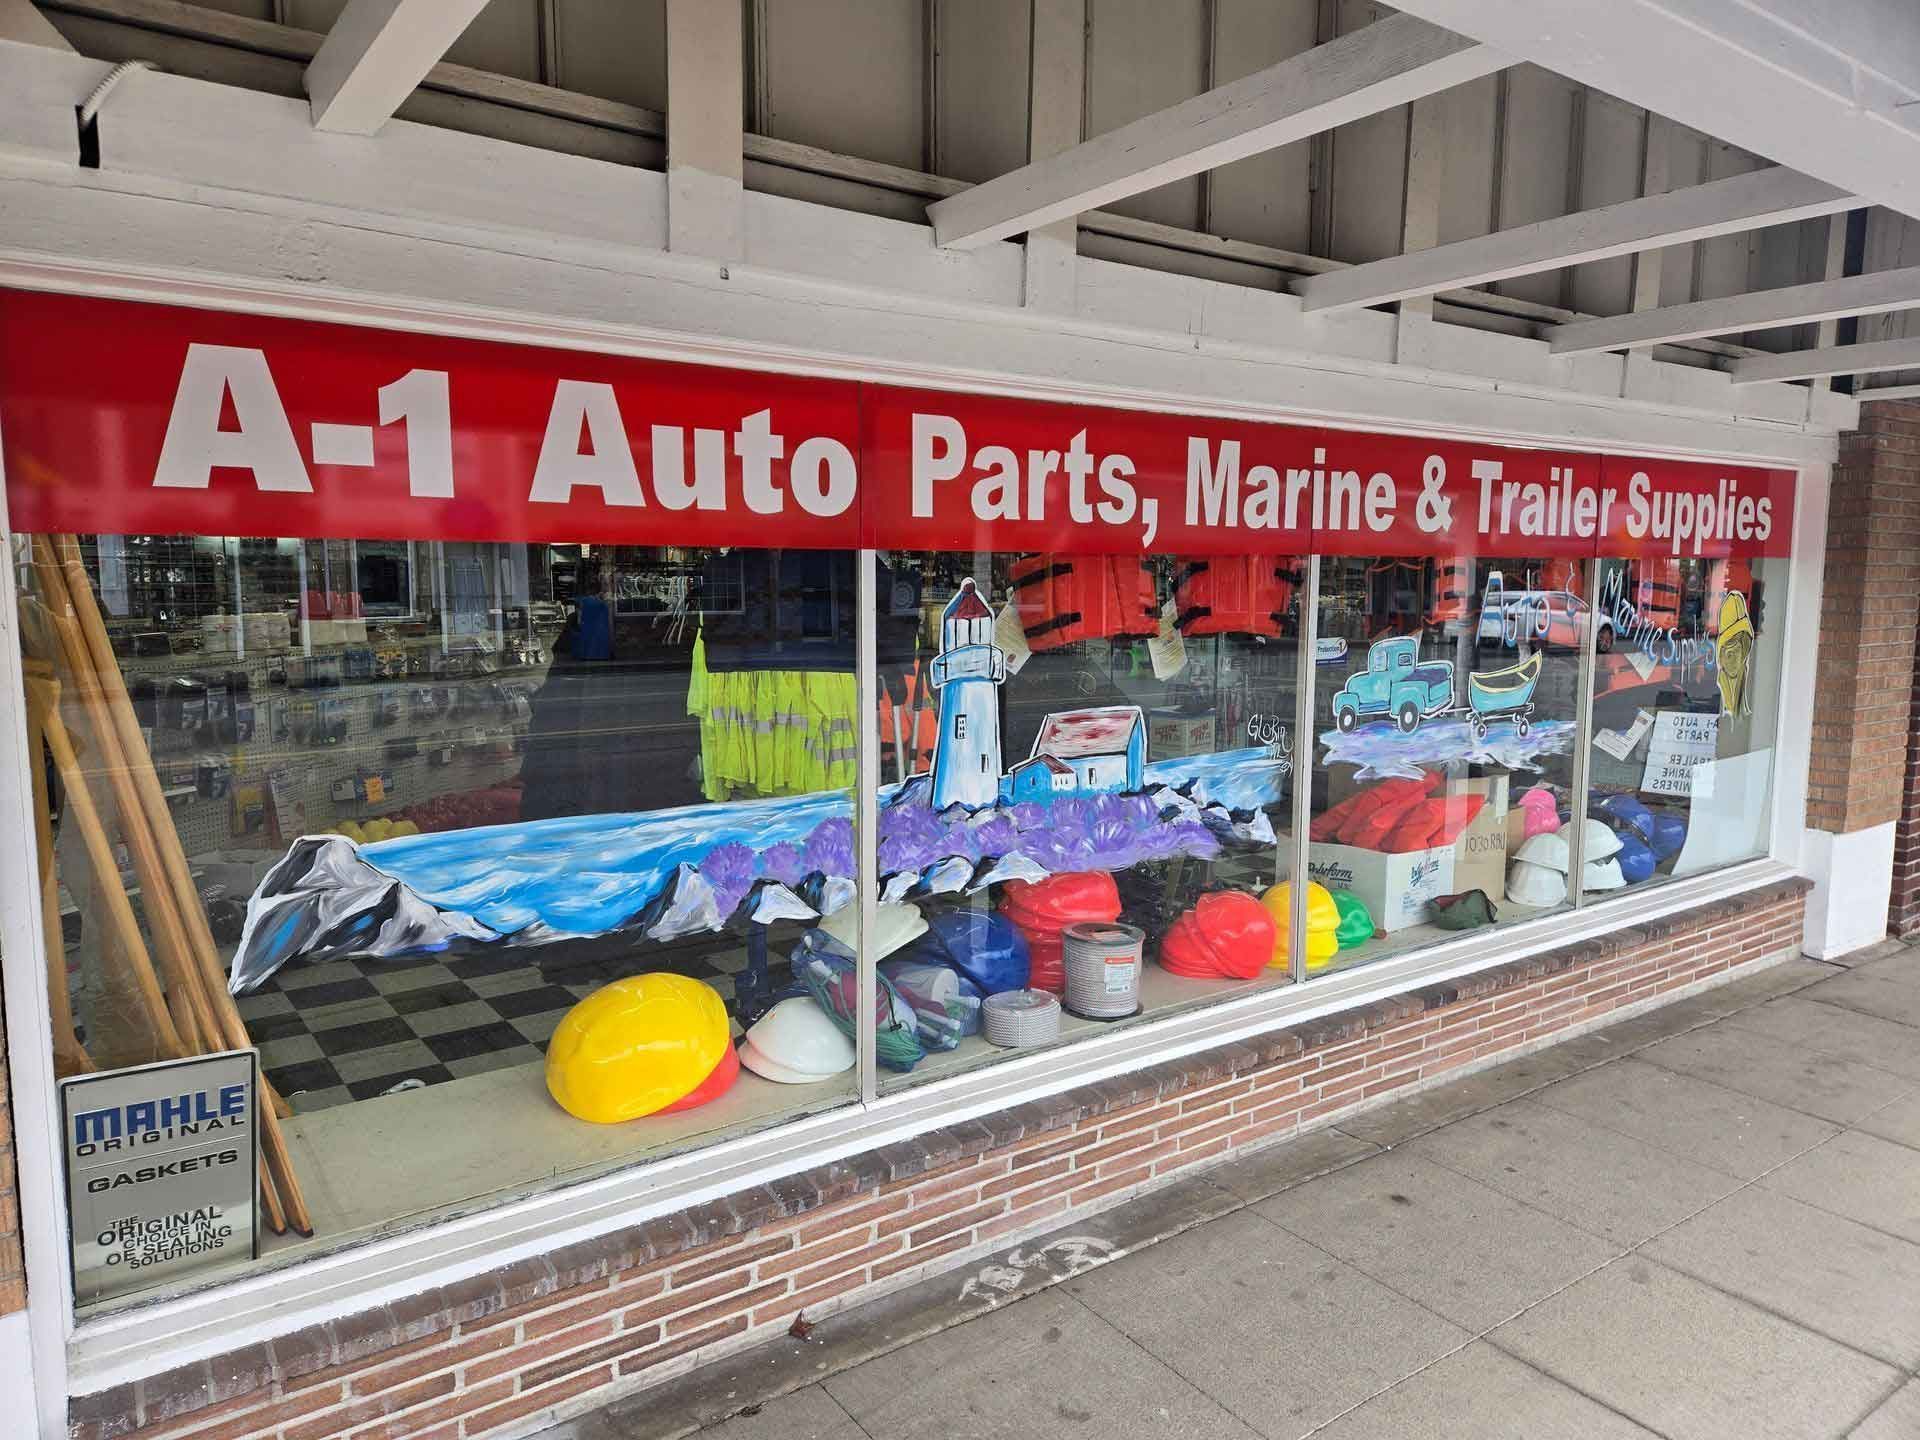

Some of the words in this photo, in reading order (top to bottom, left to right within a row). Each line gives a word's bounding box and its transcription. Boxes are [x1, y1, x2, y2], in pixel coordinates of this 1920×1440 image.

[152, 342, 454, 498] A-1
[528, 378, 857, 517] Auto
[911, 412, 1158, 549] Parts,
[1185, 436, 1397, 531] Marine
[1415, 454, 1454, 532] &
[1471, 459, 1617, 537] Trailer
[1626, 471, 1772, 555] Supplies
[1601, 568, 1663, 661] Marine
[75, 1084, 245, 1145] MAHLE
[76, 1115, 245, 1157] ORIGINAL
[87, 1149, 239, 1194] GASKETS
[97, 1206, 222, 1246] ORIGINAL
[110, 1216, 138, 1229] THE
[123, 1225, 190, 1249] CHOICE
[195, 1220, 212, 1233] IN
[106, 1250, 136, 1266] OE
[143, 1225, 232, 1257] SEALING
[130, 1238, 224, 1269] SOLUTIONS
